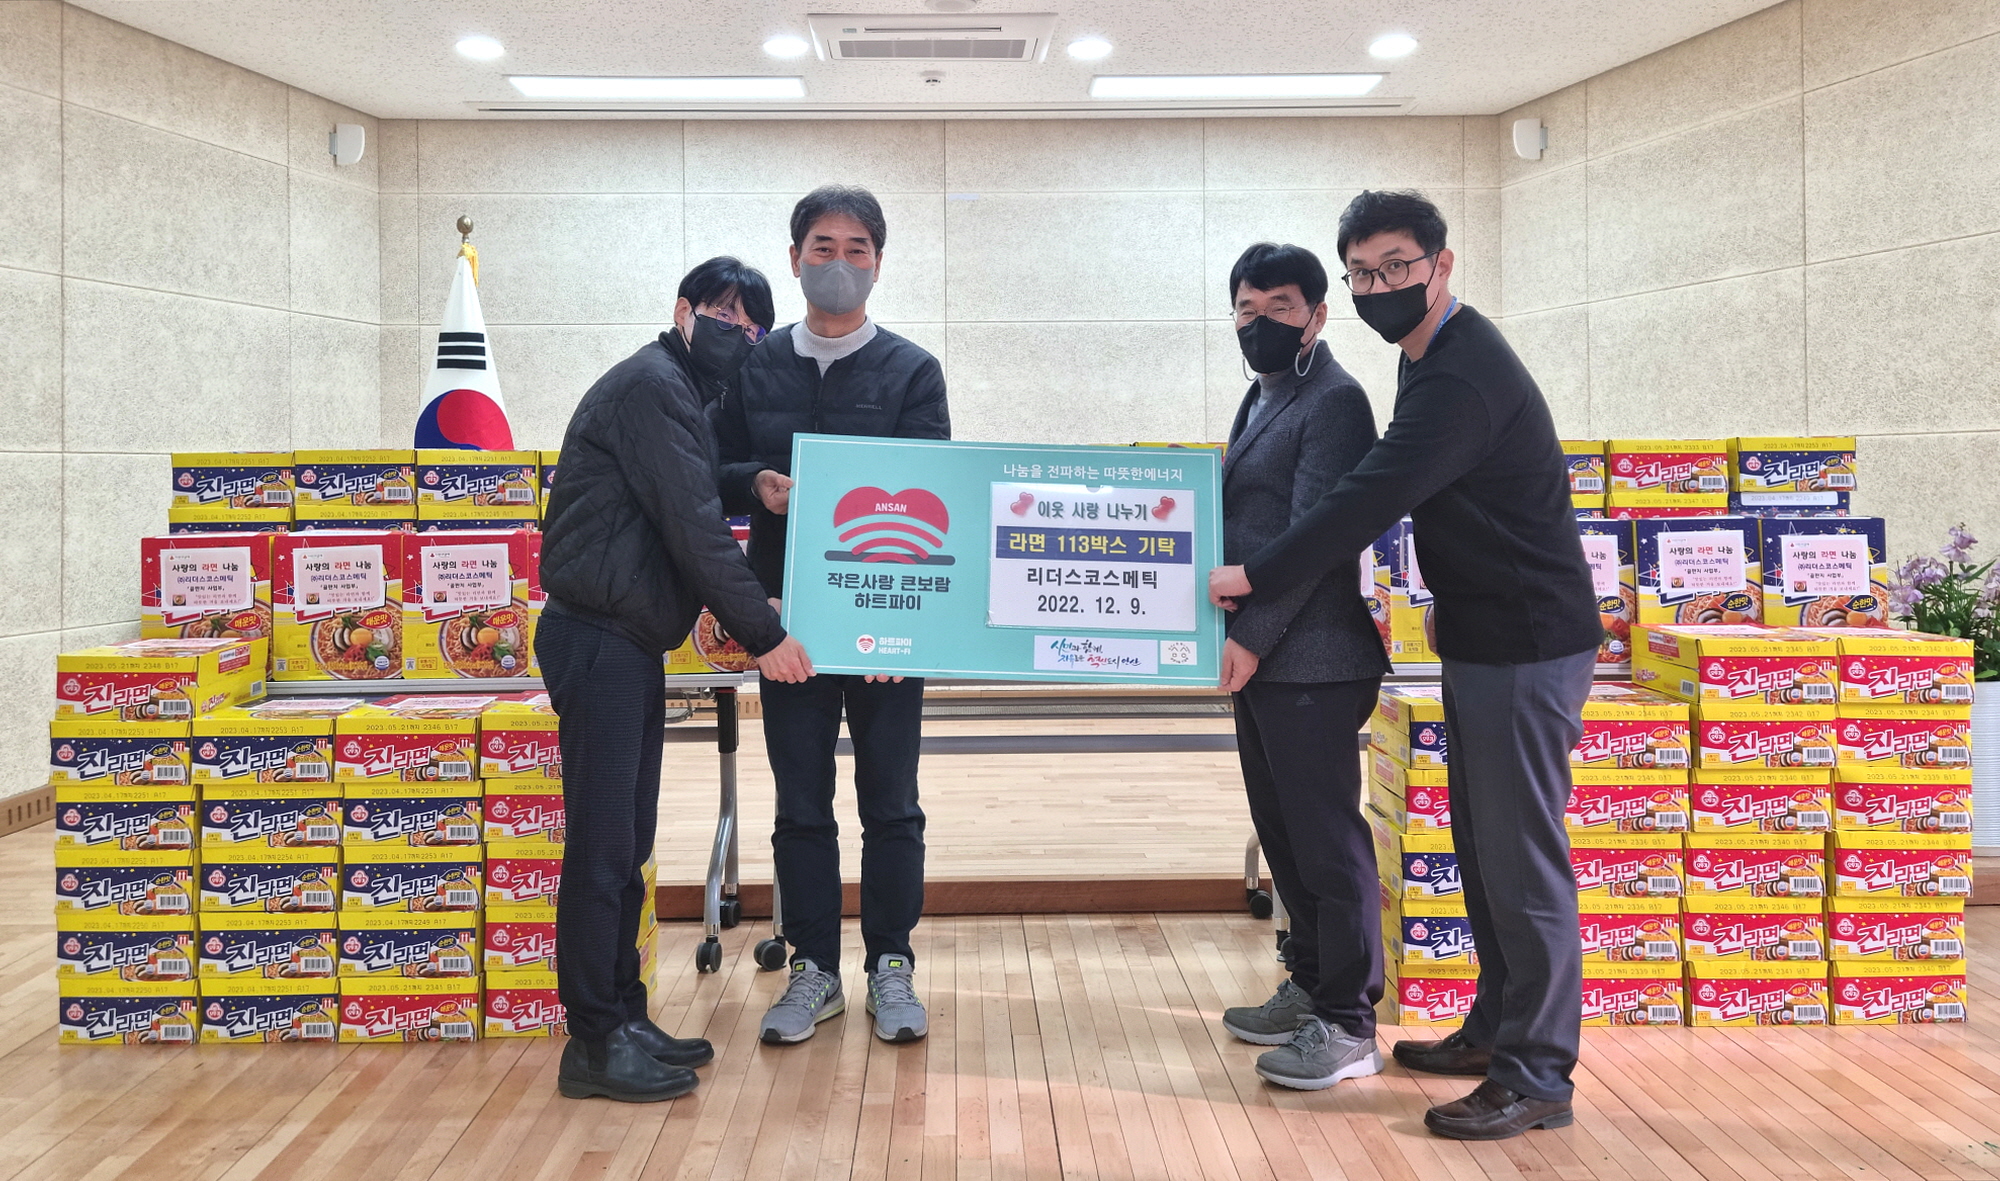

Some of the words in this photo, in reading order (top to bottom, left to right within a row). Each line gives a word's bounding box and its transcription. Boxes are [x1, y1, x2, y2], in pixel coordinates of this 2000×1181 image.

[442, 474, 498, 502] 진라면
[1004, 464, 1042, 479] 나눔을
[1048, 465, 1099, 480] 전파하는
[1104, 467, 1182, 482] 따뜻한에너지
[1635, 462, 1691, 488] 진라면
[1764, 459, 1819, 487] 진라면
[197, 476, 255, 505] 진라면
[319, 474, 376, 503] 진라면
[875, 502, 907, 513] ANSAN
[1037, 500, 1065, 519] 이웃
[1072, 501, 1100, 520] 사랑
[1106, 502, 1148, 521] 나누기
[1009, 533, 1046, 553] 라면
[1057, 534, 1127, 555] 113박스
[1138, 536, 1176, 556] 기탁
[1591, 552, 1606, 560] 나눔
[1670, 547, 1693, 556] 사랑의
[1698, 546, 1713, 555] 라면
[1718, 546, 1733, 554] 나눔
[1793, 551, 1816, 560] 사랑의
[1821, 551, 1836, 559] 라면
[1841, 551, 1856, 559] 나눔
[172, 564, 197, 573] 사랑의
[202, 563, 218, 571] 라면
[223, 563, 238, 571] 나눔
[306, 562, 329, 571] 사랑의
[335, 561, 350, 570] 라면
[356, 561, 371, 569] 나눔
[433, 561, 456, 570] 사랑의
[462, 560, 477, 569] 라면
[482, 560, 497, 568] 나눔
[1027, 567, 1158, 589] 리더스코스메틱
[827, 572, 895, 592] 작은사랑
[901, 572, 951, 593] 큰보람
[854, 592, 922, 611] 하트파이
[1037, 595, 1085, 614] 2022.
[1095, 597, 1120, 615] 12.
[1130, 597, 1147, 616] 9.
[1727, 597, 1748, 610] 순한맛
[1852, 596, 1873, 609] 순한맛
[234, 615, 256, 628] 매운맛
[366, 614, 388, 626] 매운맛
[492, 614, 513, 626] 매운맛
[879, 637, 912, 646] 하트파이
[1728, 667, 1794, 699] 진라면
[1868, 667, 1933, 699] 진라면
[83, 684, 150, 714] 진라면
[1580, 731, 1646, 763] 진라면
[1728, 730, 1794, 763] 진라면
[1864, 729, 1930, 761] 진라면
[77, 750, 144, 780] 진라면
[220, 748, 287, 778] 진라면
[364, 745, 431, 776] 진라면
[230, 809, 298, 842] 진라면
[371, 809, 437, 841] 진라면
[1580, 796, 1646, 827] 진라면
[1722, 795, 1789, 826] 진라면
[1865, 795, 1932, 826] 진라면
[83, 811, 150, 845] 진라면
[371, 874, 437, 906] 진라면
[1574, 860, 1638, 890] 진라면
[1714, 860, 1780, 891] 진라면
[1865, 861, 1931, 892] 진라면
[82, 878, 147, 910] 진라면
[229, 875, 294, 906] 진라면
[1714, 924, 1780, 956] 진라면
[1857, 923, 1922, 955] 진라면
[83, 942, 150, 973] 진라면
[226, 940, 291, 971] 진라면
[363, 941, 430, 972] 진라면
[1720, 989, 1785, 1021] 진라면
[1862, 987, 1925, 1020] 진라면
[86, 1007, 151, 1039] 진라면
[226, 1007, 294, 1039] 진라면
[366, 1006, 432, 1037] 진라면
